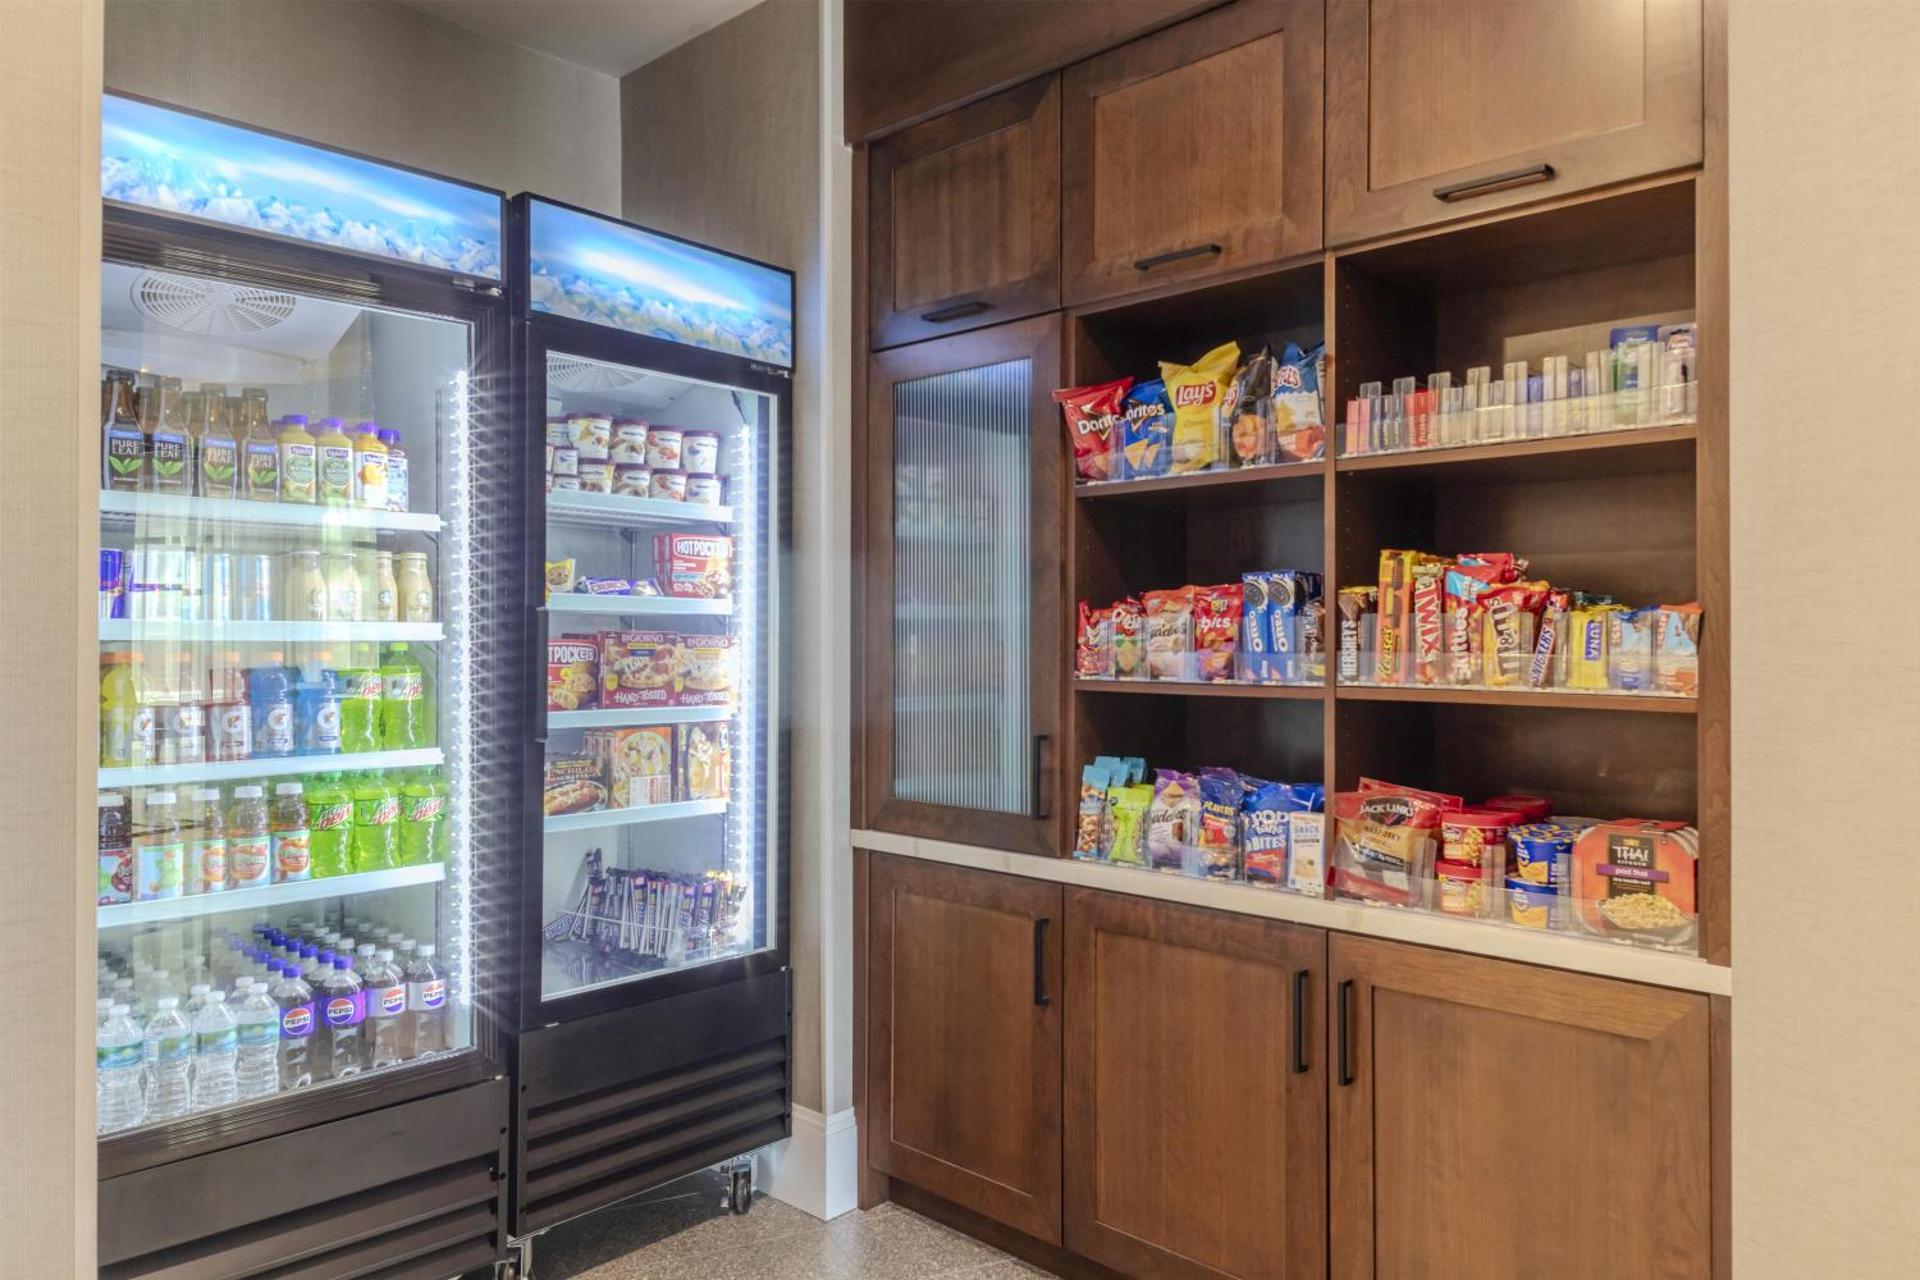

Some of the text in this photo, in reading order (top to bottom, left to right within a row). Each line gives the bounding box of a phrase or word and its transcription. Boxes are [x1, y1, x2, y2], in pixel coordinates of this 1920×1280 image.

[1415, 579, 1441, 657] TWIX
[1612, 846, 1649, 861] THAI
[328, 1006, 354, 1015] PEPSI
